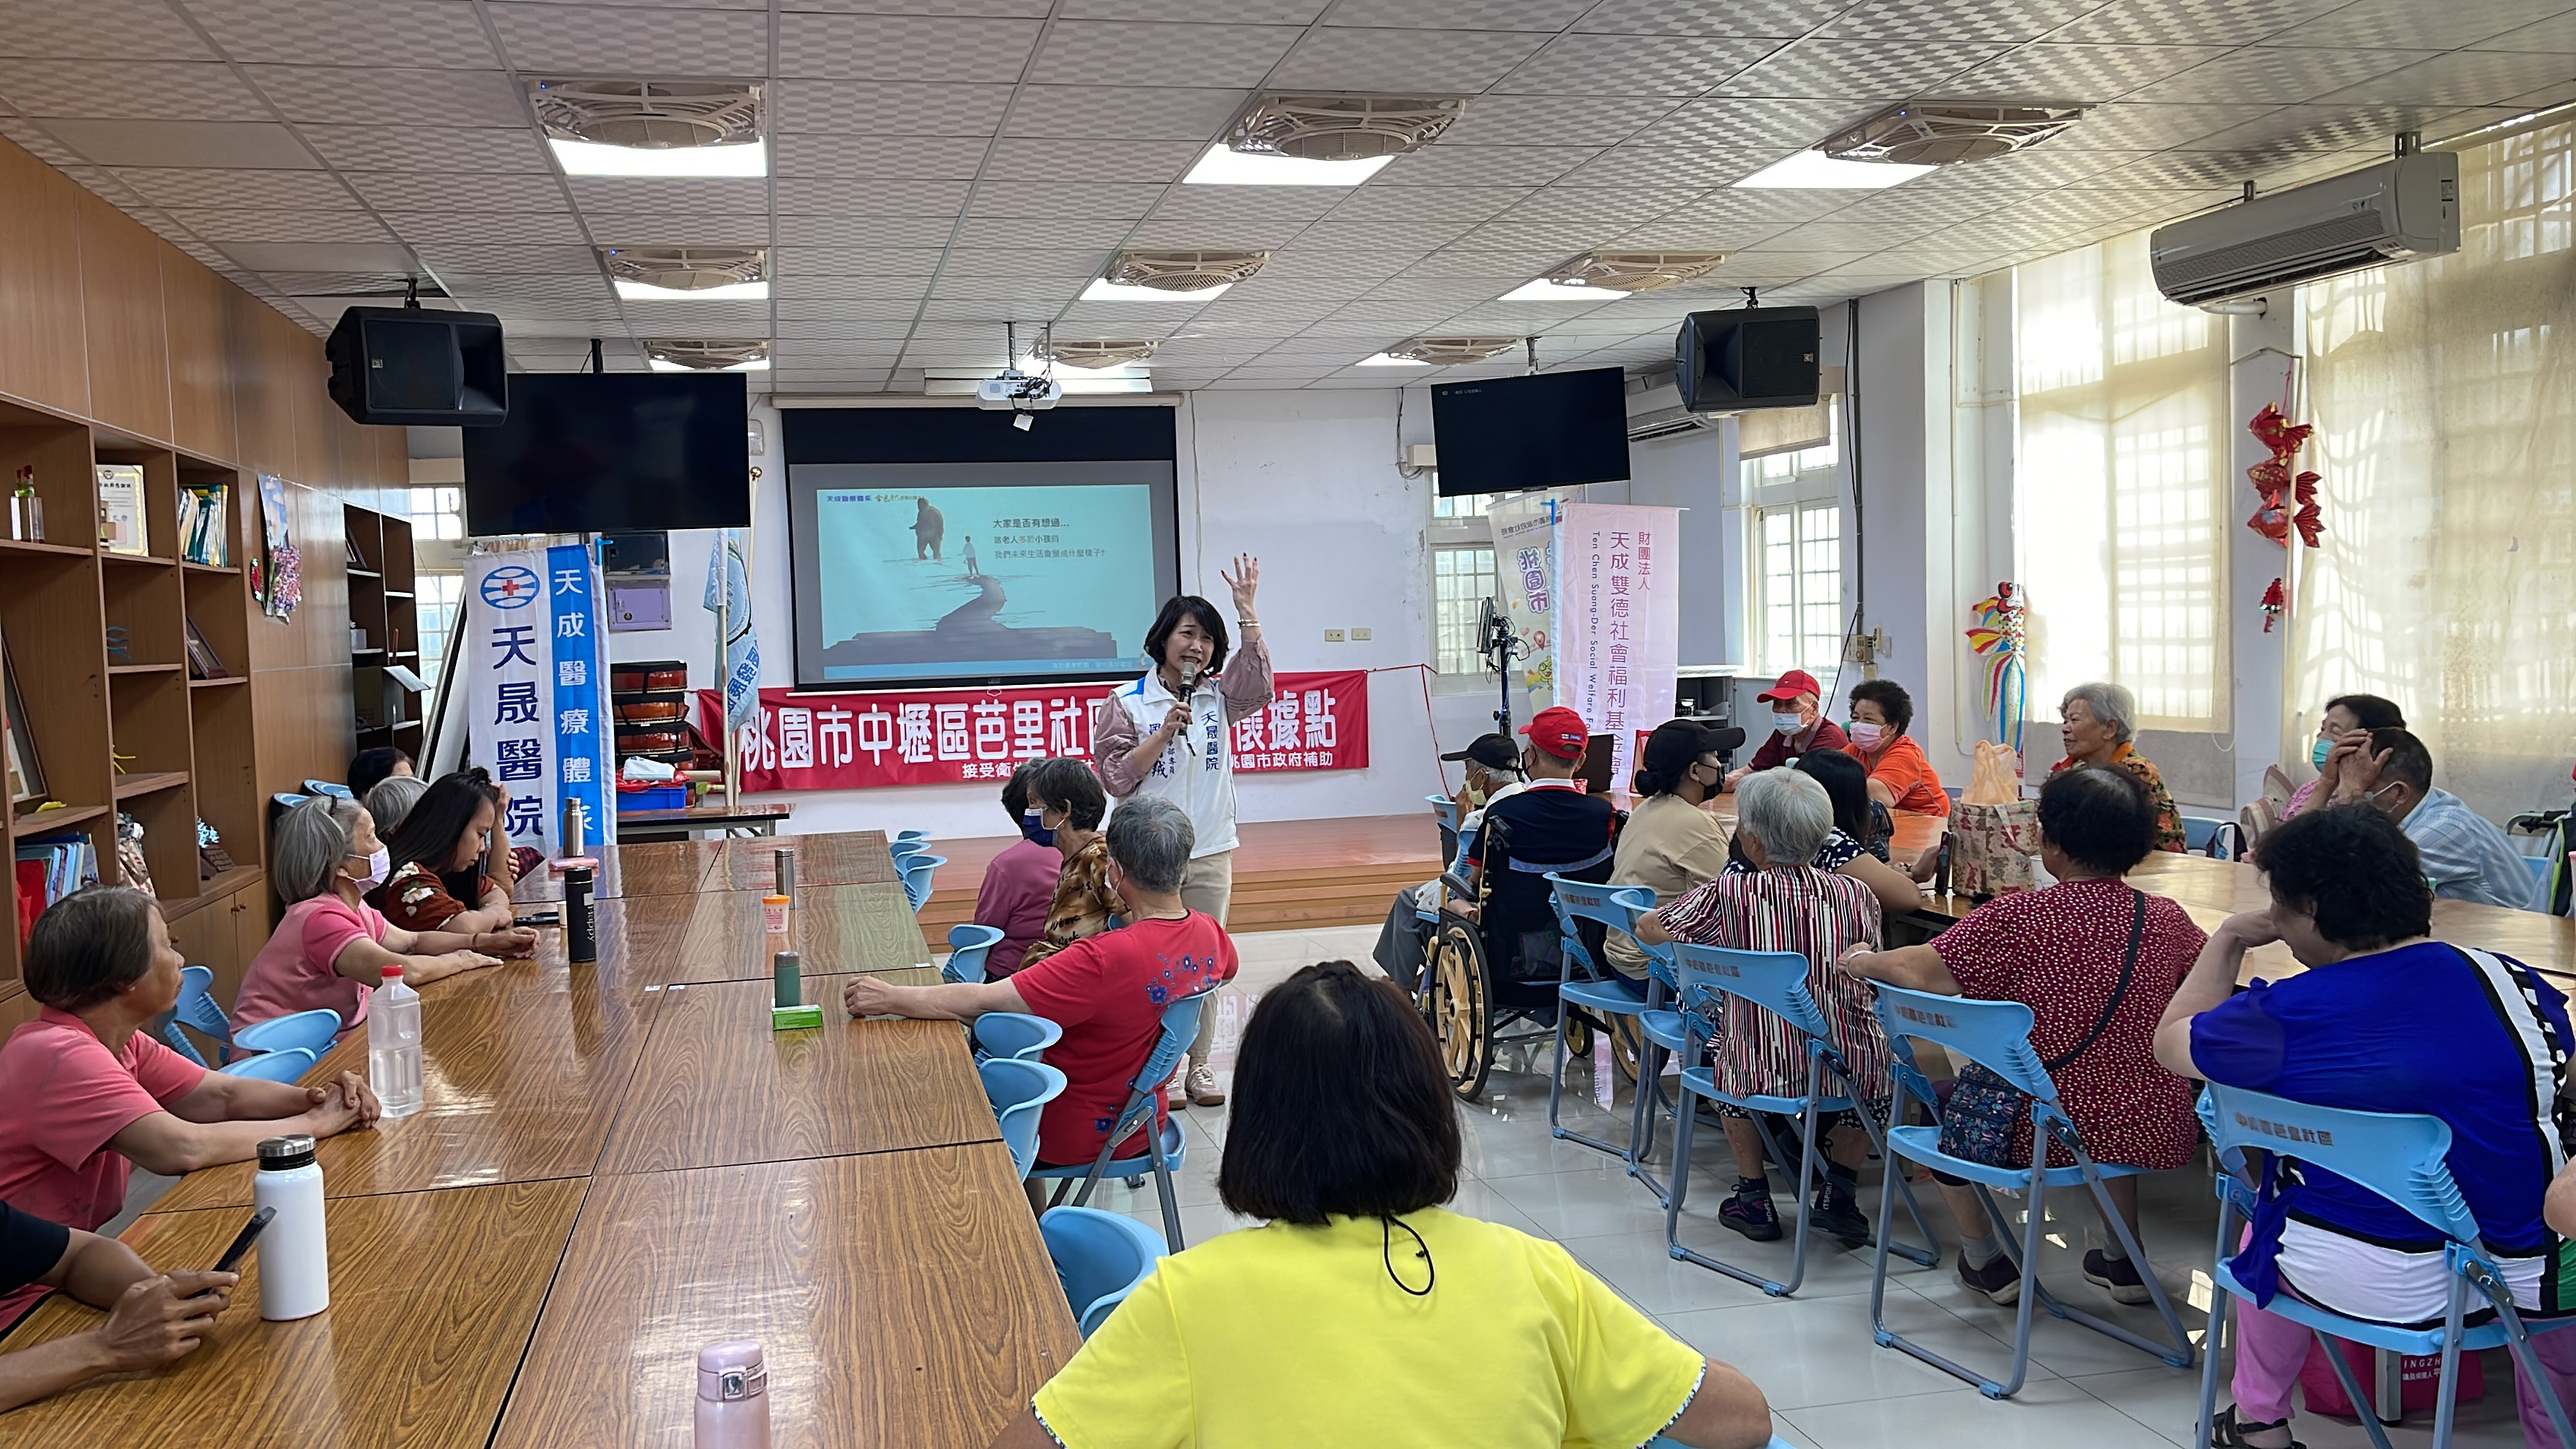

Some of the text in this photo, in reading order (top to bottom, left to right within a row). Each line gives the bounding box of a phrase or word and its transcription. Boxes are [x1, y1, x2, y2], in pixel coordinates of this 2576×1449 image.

[1592, 531, 1600, 549] Ten
[1638, 531, 1651, 591] 財團法人
[1592, 554, 1600, 579] Chen
[1590, 584, 1599, 634] Suang-Der
[1590, 640, 1598, 669] Social
[1586, 674, 1597, 713] Welfare
[492, 626, 543, 837] 天晟醫院
[1201, 711, 1219, 771] 天晟醫院
